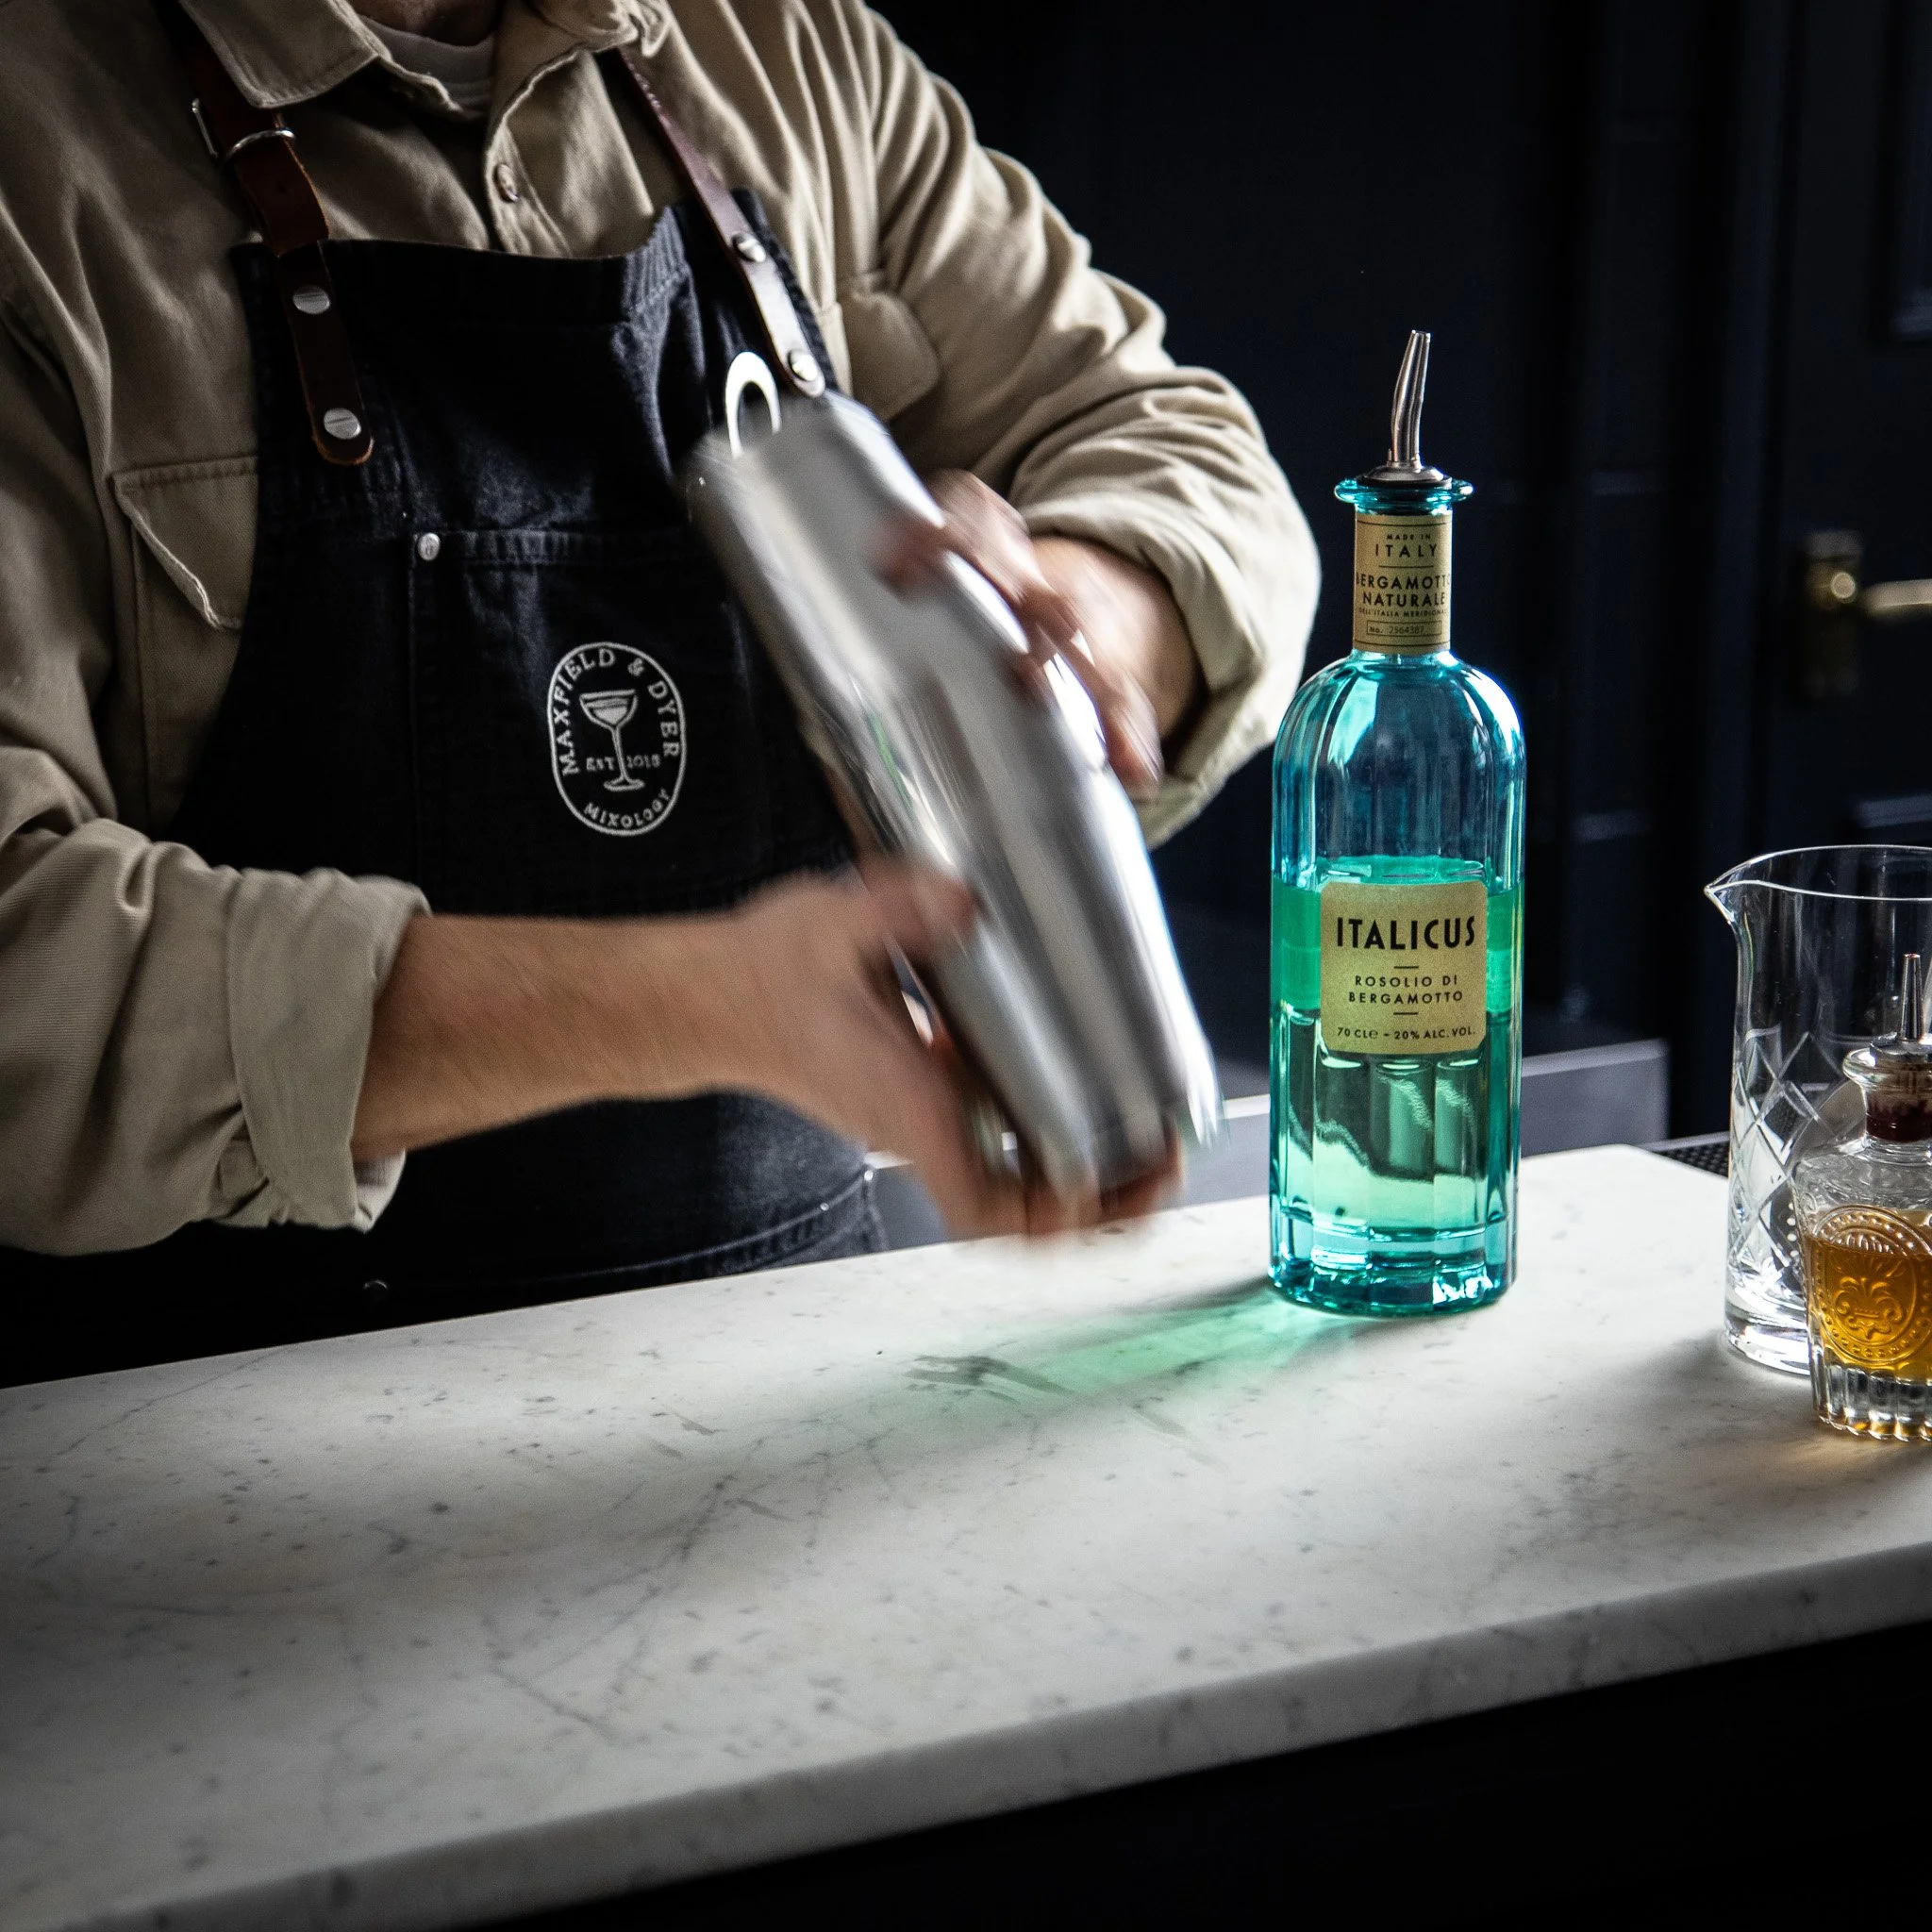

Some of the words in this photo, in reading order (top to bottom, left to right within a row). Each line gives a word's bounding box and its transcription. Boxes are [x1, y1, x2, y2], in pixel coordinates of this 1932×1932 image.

[1375, 543, 1437, 558] ITALY
[1363, 591, 1445, 607] NATURALE
[554, 648, 616, 776] MAXFIELD
[627, 658, 645, 676] &
[647, 680, 680, 758] DYER
[586, 757, 614, 772] EST
[584, 787, 670, 828] MIXOLOGY
[1337, 915, 1474, 950] ITALICUS
[1355, 975, 1432, 988] ROSOLIO
[1442, 974, 1457, 986] DI
[1349, 991, 1463, 1005] BERGAMOTTO
[1337, 1026, 1351, 1037] 70
[1394, 1030, 1420, 1041] 20%
